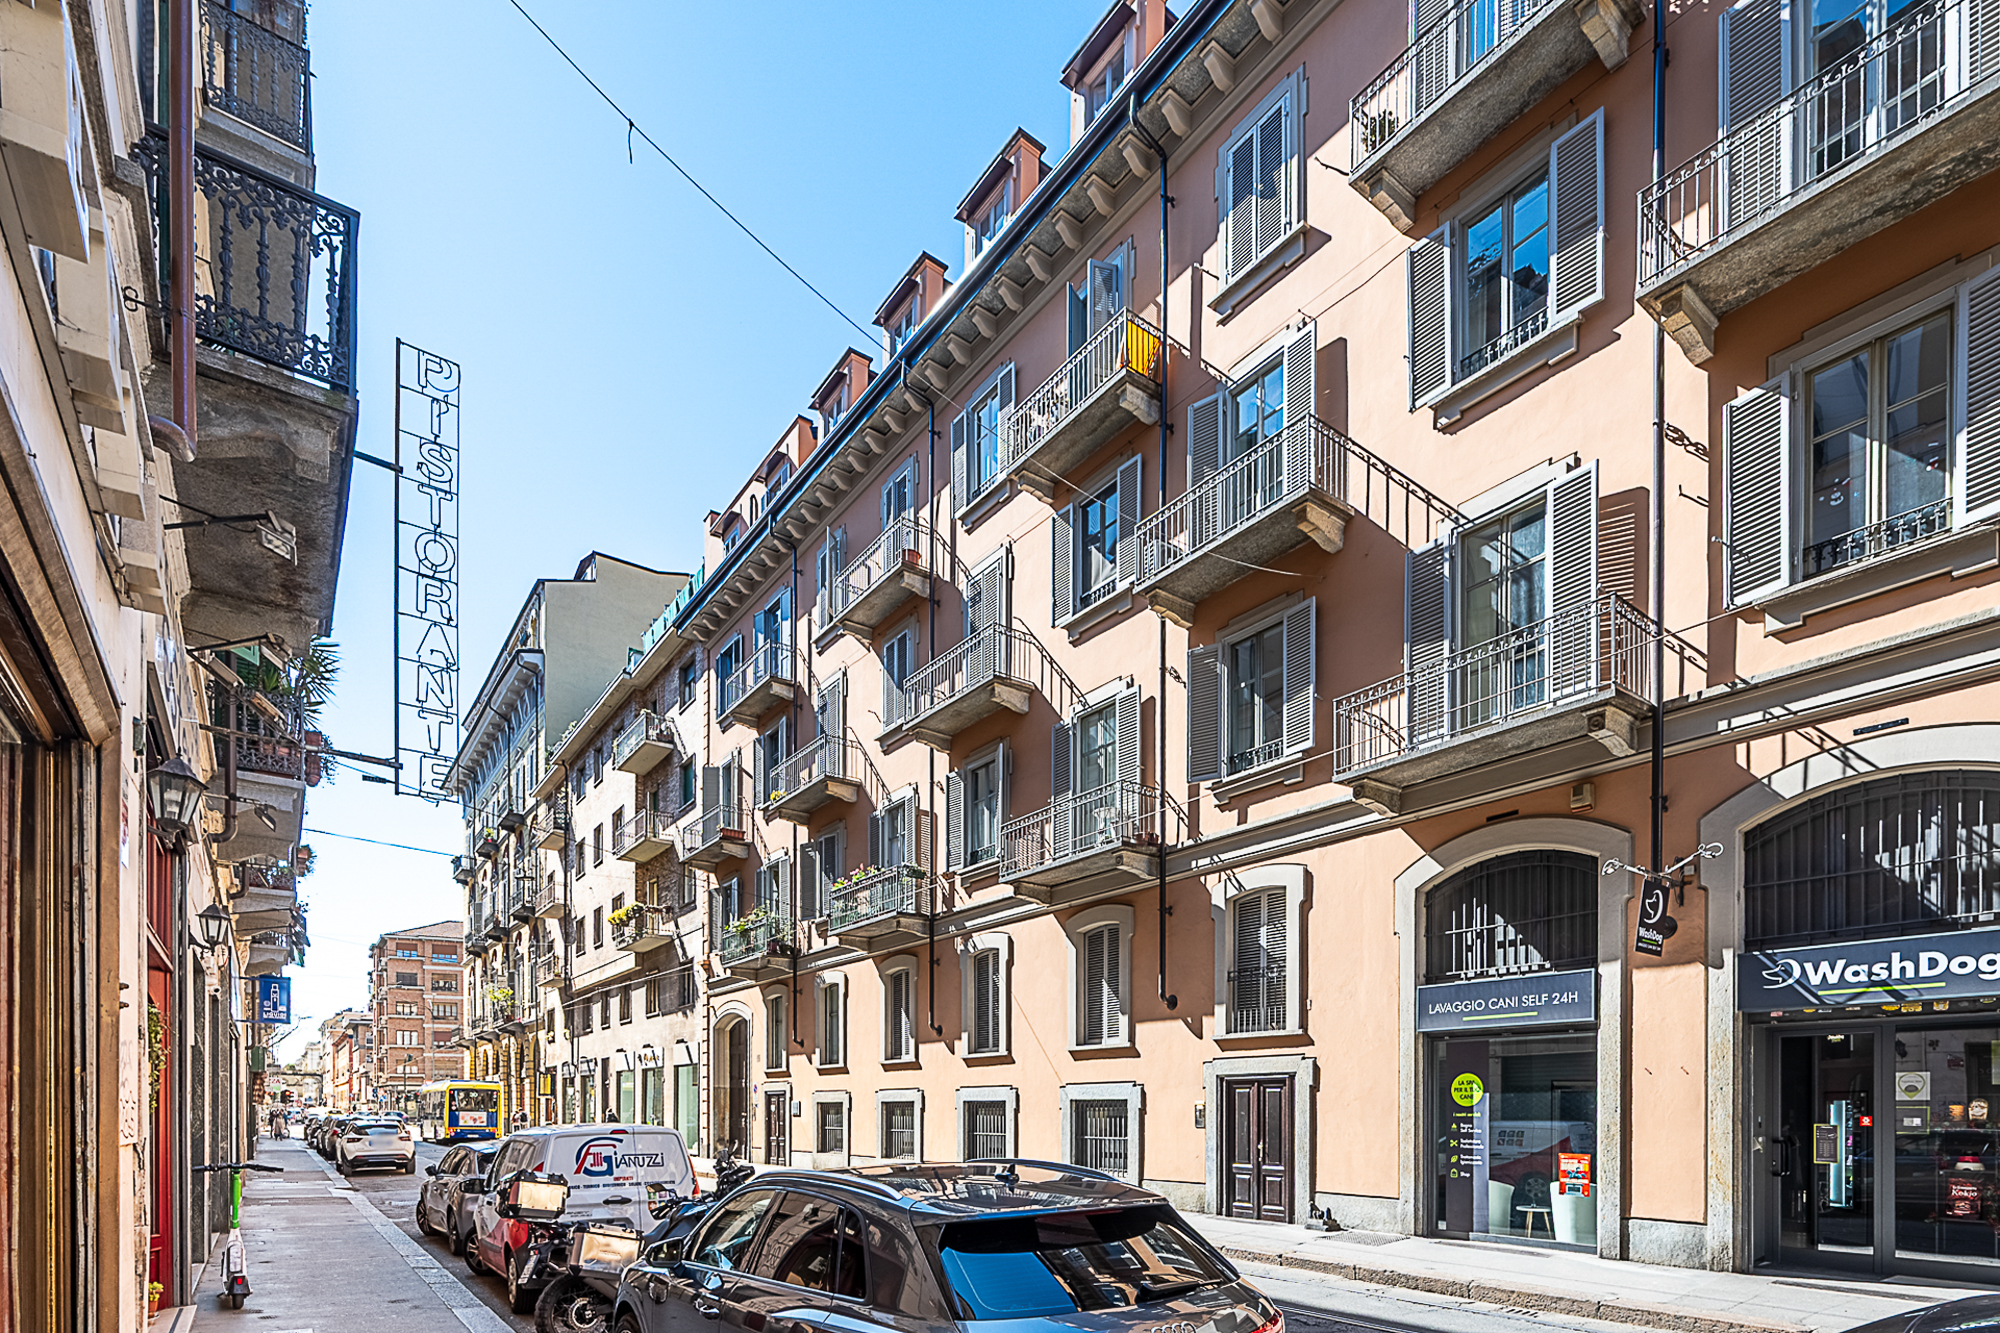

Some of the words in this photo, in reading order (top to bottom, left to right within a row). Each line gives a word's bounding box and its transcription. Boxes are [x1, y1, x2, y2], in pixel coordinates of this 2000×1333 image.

[1638, 926, 1663, 945] WashDog
[1803, 951, 2000, 986] WashDog
[1428, 999, 1485, 1015] LAVAGGIO
[1488, 996, 1519, 1010] CANI
[1521, 993, 1549, 1007] SELF
[1551, 991, 1579, 1005] 24H
